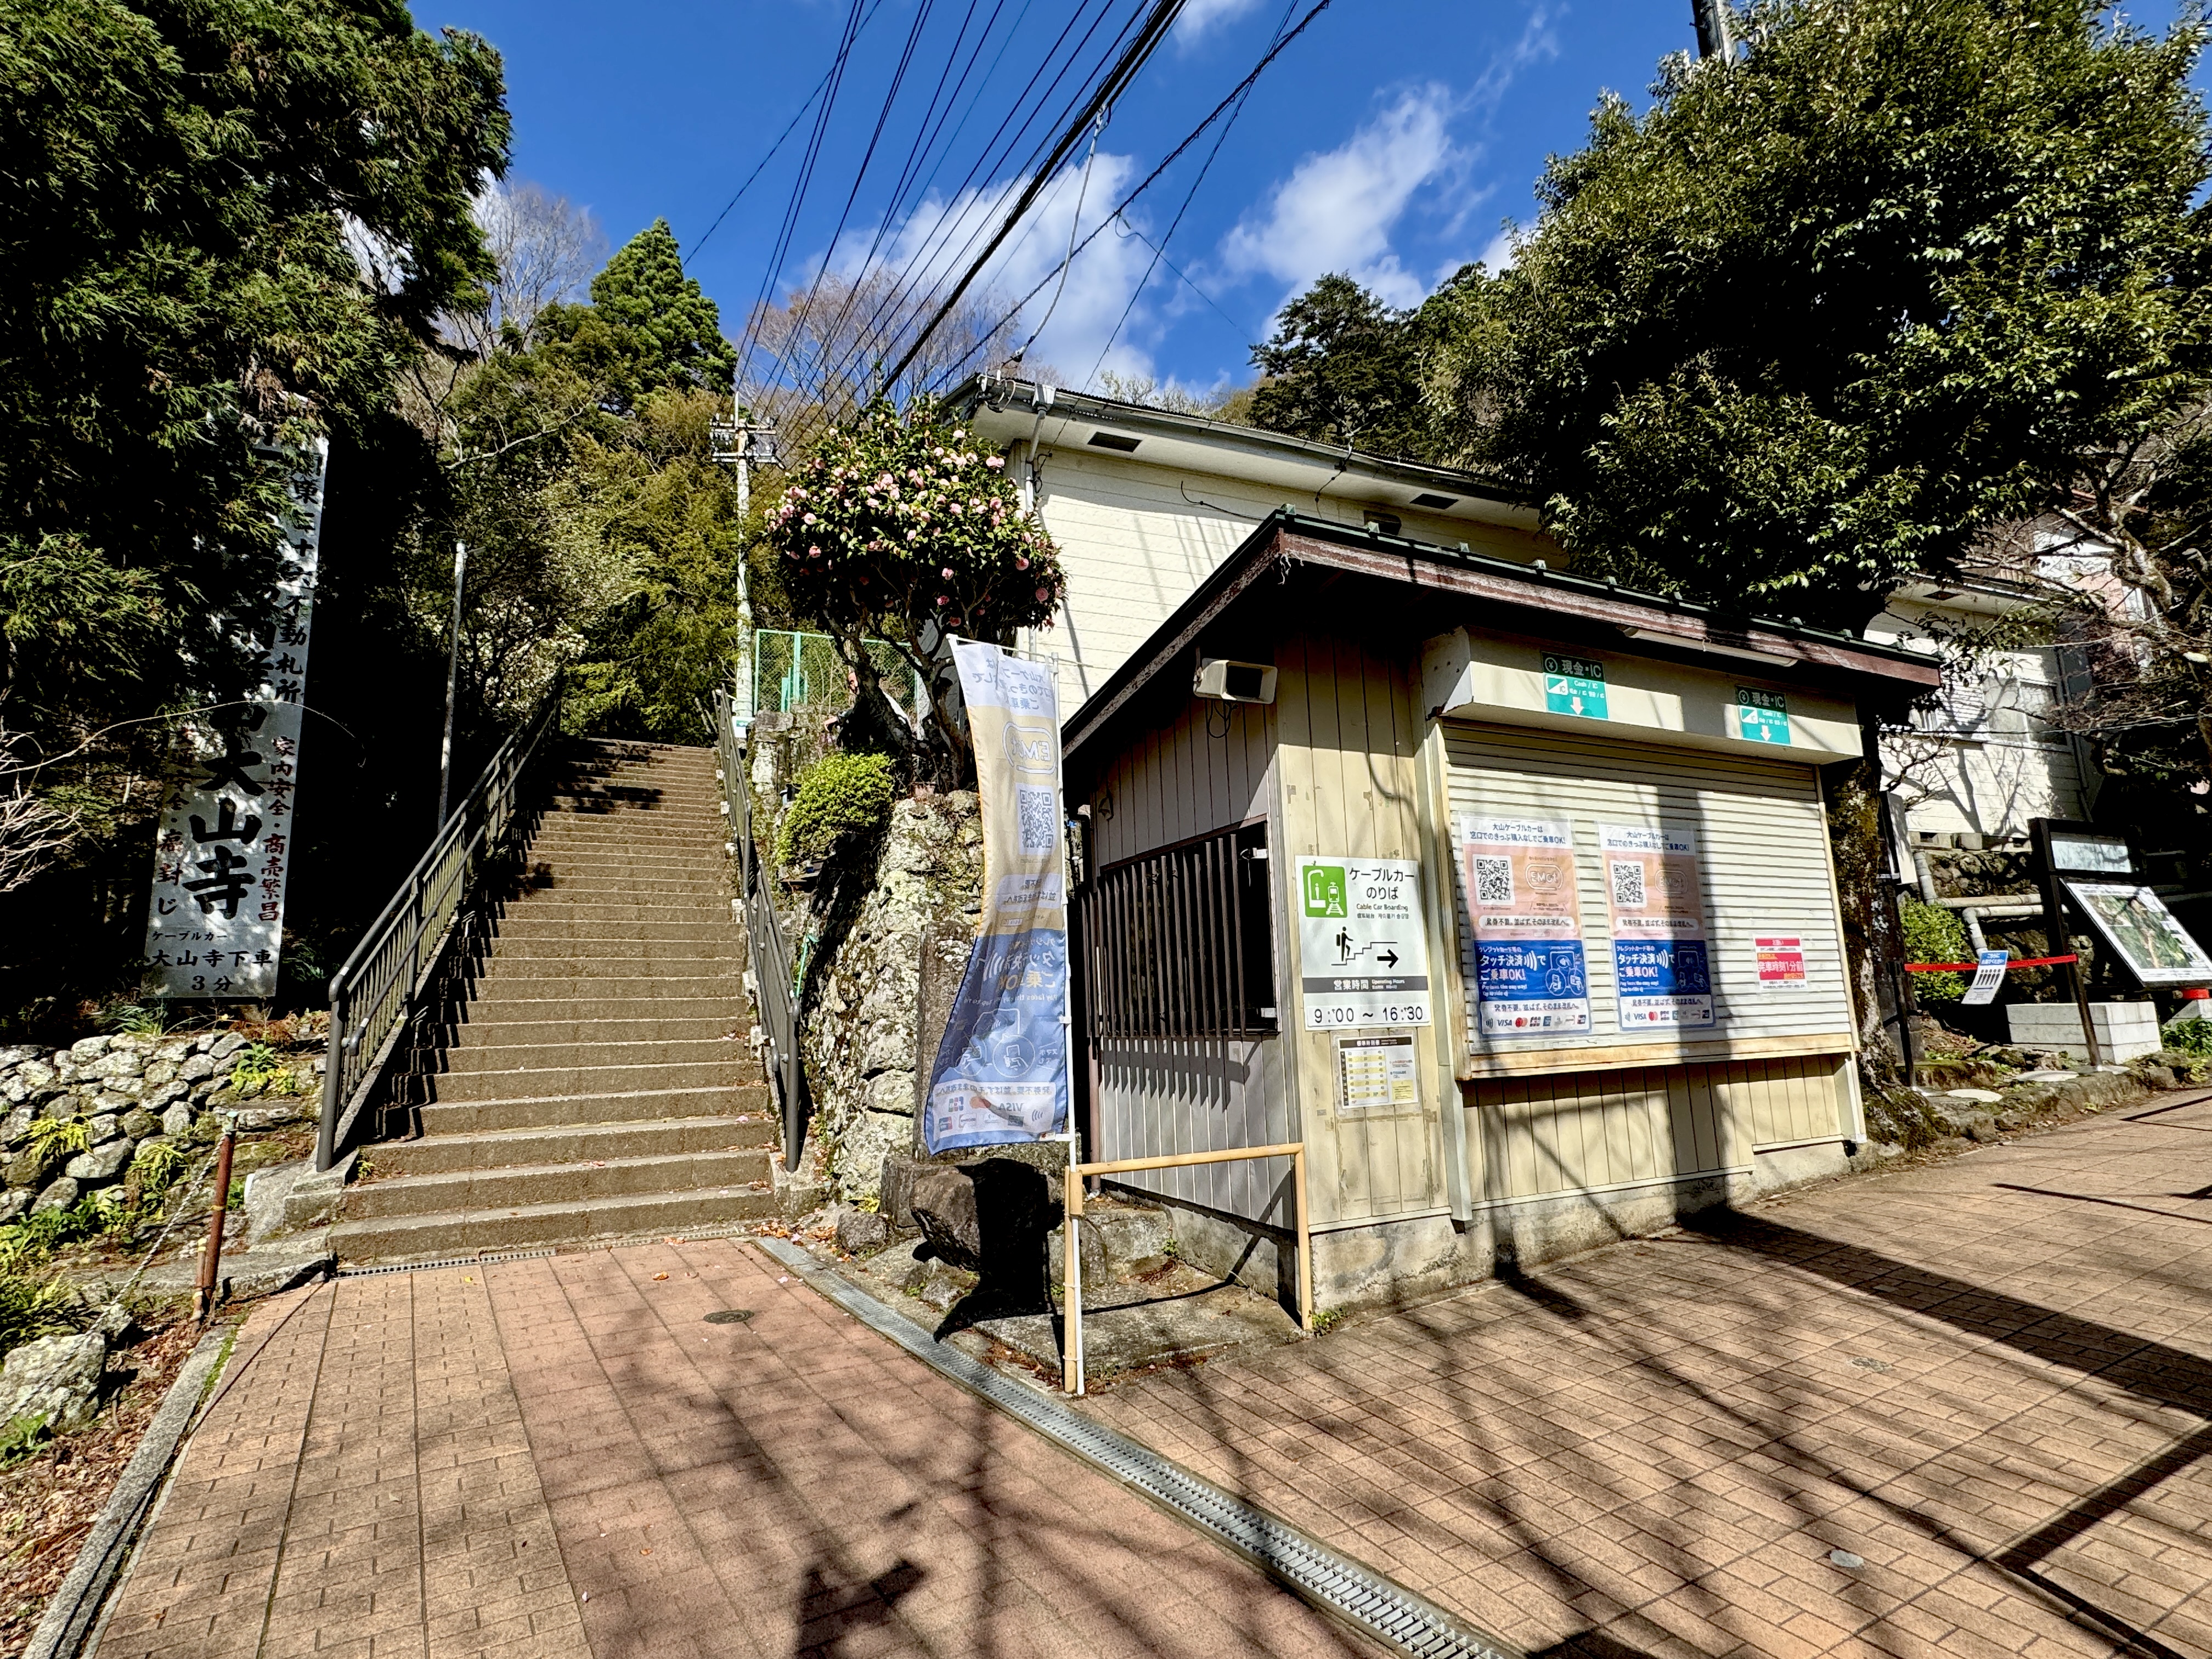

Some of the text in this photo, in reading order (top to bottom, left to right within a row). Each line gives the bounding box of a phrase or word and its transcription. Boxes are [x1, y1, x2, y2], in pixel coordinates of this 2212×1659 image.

[258, 736, 296, 922] 家内安全・商売繁昌
[1492, 823, 1544, 833] 大山ケーブルカーは
[1349, 867, 1415, 882] ケーブルカー
[1366, 887, 1399, 900] のりば
[1384, 904, 1409, 912] Boarding
[152, 930, 228, 941] ケーブルカー
[150, 949, 273, 968] 大山寺下車
[1480, 954, 1547, 967] タッチ決済 で
[1618, 953, 1656, 965] タッチ決済
[1480, 968, 1527, 983] ご乗車OK!
[1618, 966, 1658, 978] ご乗車OK!
[191, 975, 234, 992] 3分
[1333, 979, 1369, 991] 営業時間
[1314, 1007, 1354, 1023] 9:00
[1383, 1006, 1423, 1022] 16:30
[1497, 1019, 1513, 1027] VISA
